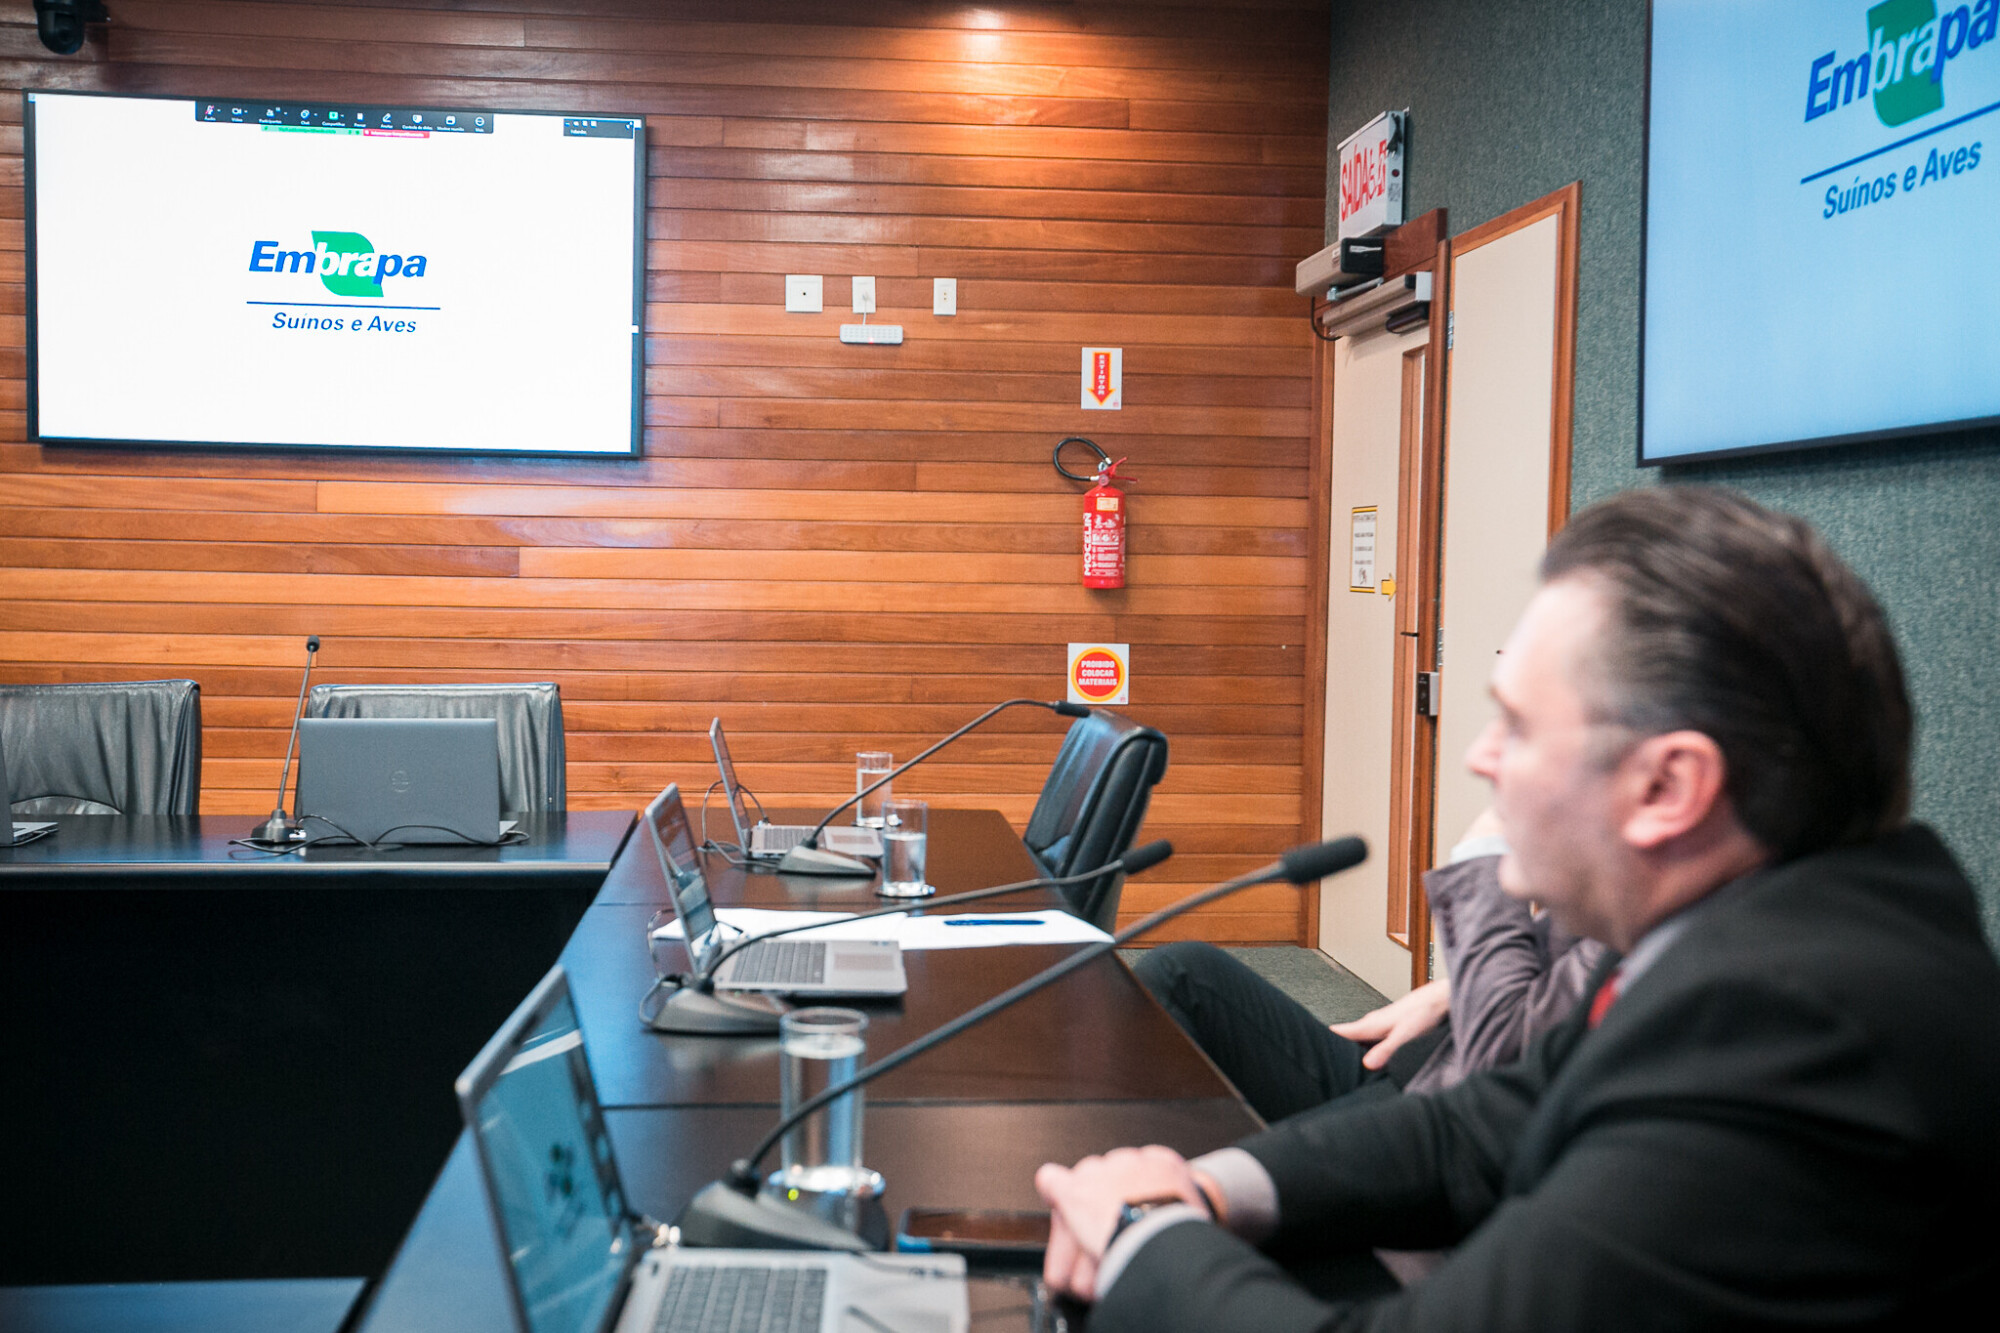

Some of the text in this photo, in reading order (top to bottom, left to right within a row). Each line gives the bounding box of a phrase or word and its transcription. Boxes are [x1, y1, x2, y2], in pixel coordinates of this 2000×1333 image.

[1804, 0, 2000, 123] Embrapa
[1341, 143, 1368, 222] SAÍDA
[1823, 141, 1982, 220] Suínos e Aves
[249, 240, 428, 285] Embrapa
[351, 319, 362, 331] e
[367, 316, 417, 332] Aves
[1083, 512, 1092, 576] MOCELIN
[1078, 678, 1117, 686] MATERIAIS
[1081, 660, 1115, 668] PROIBIDO
[1081, 669, 1115, 677] COLOCAR
